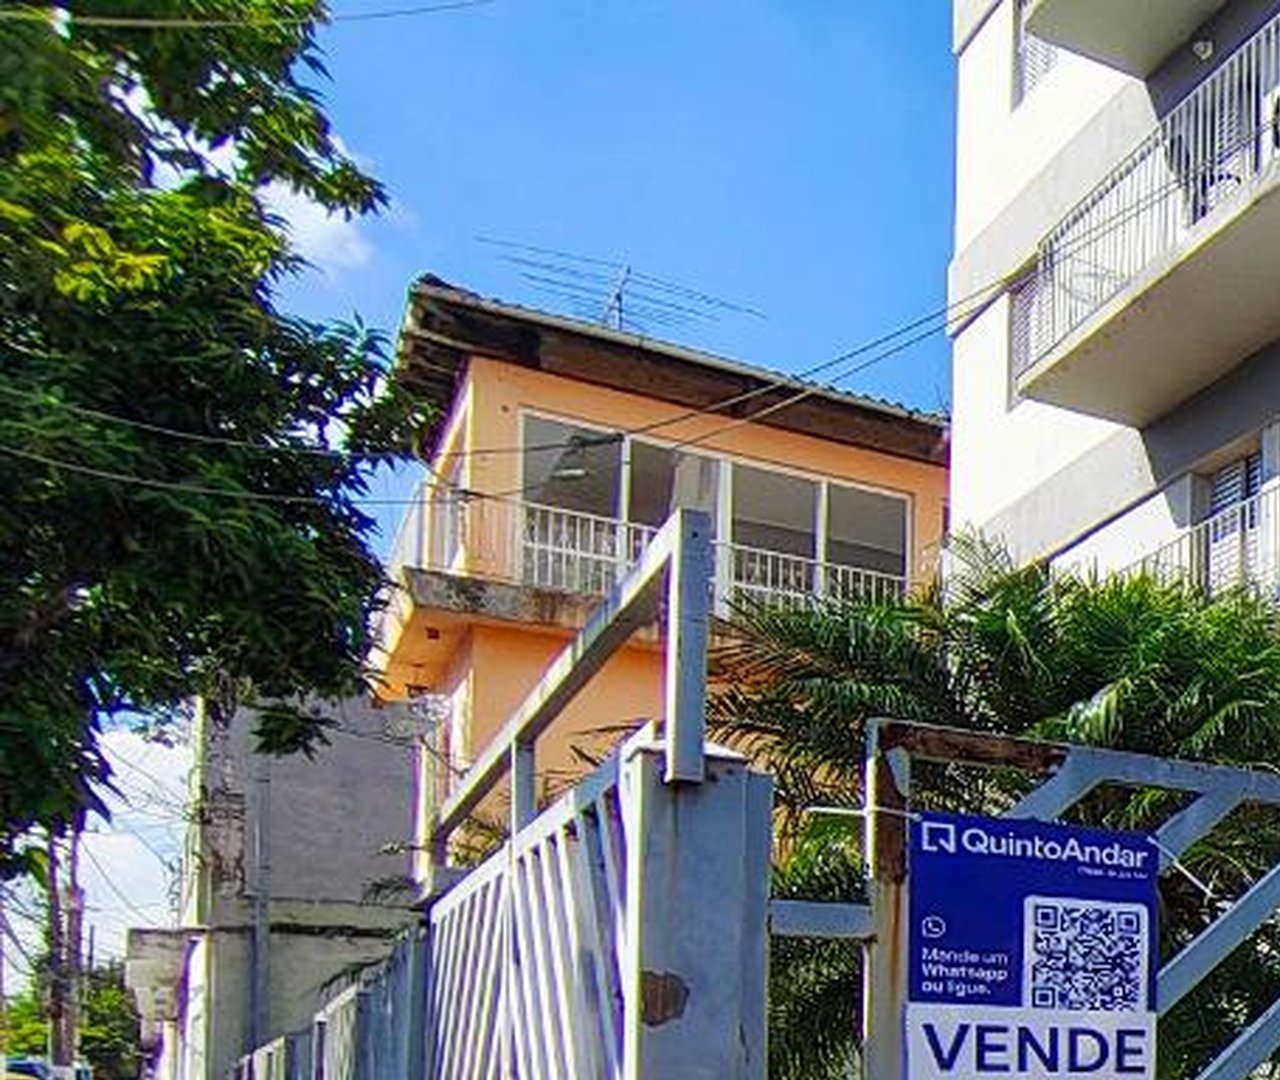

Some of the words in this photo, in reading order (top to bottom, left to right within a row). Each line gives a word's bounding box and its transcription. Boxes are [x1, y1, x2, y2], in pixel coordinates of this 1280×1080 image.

[961, 828, 1149, 868] QuintoAndar
[921, 947, 980, 963] Mande
[981, 953, 1009, 965] um
[921, 981, 944, 993] ou
[921, 1024, 1146, 1073] VENDE
